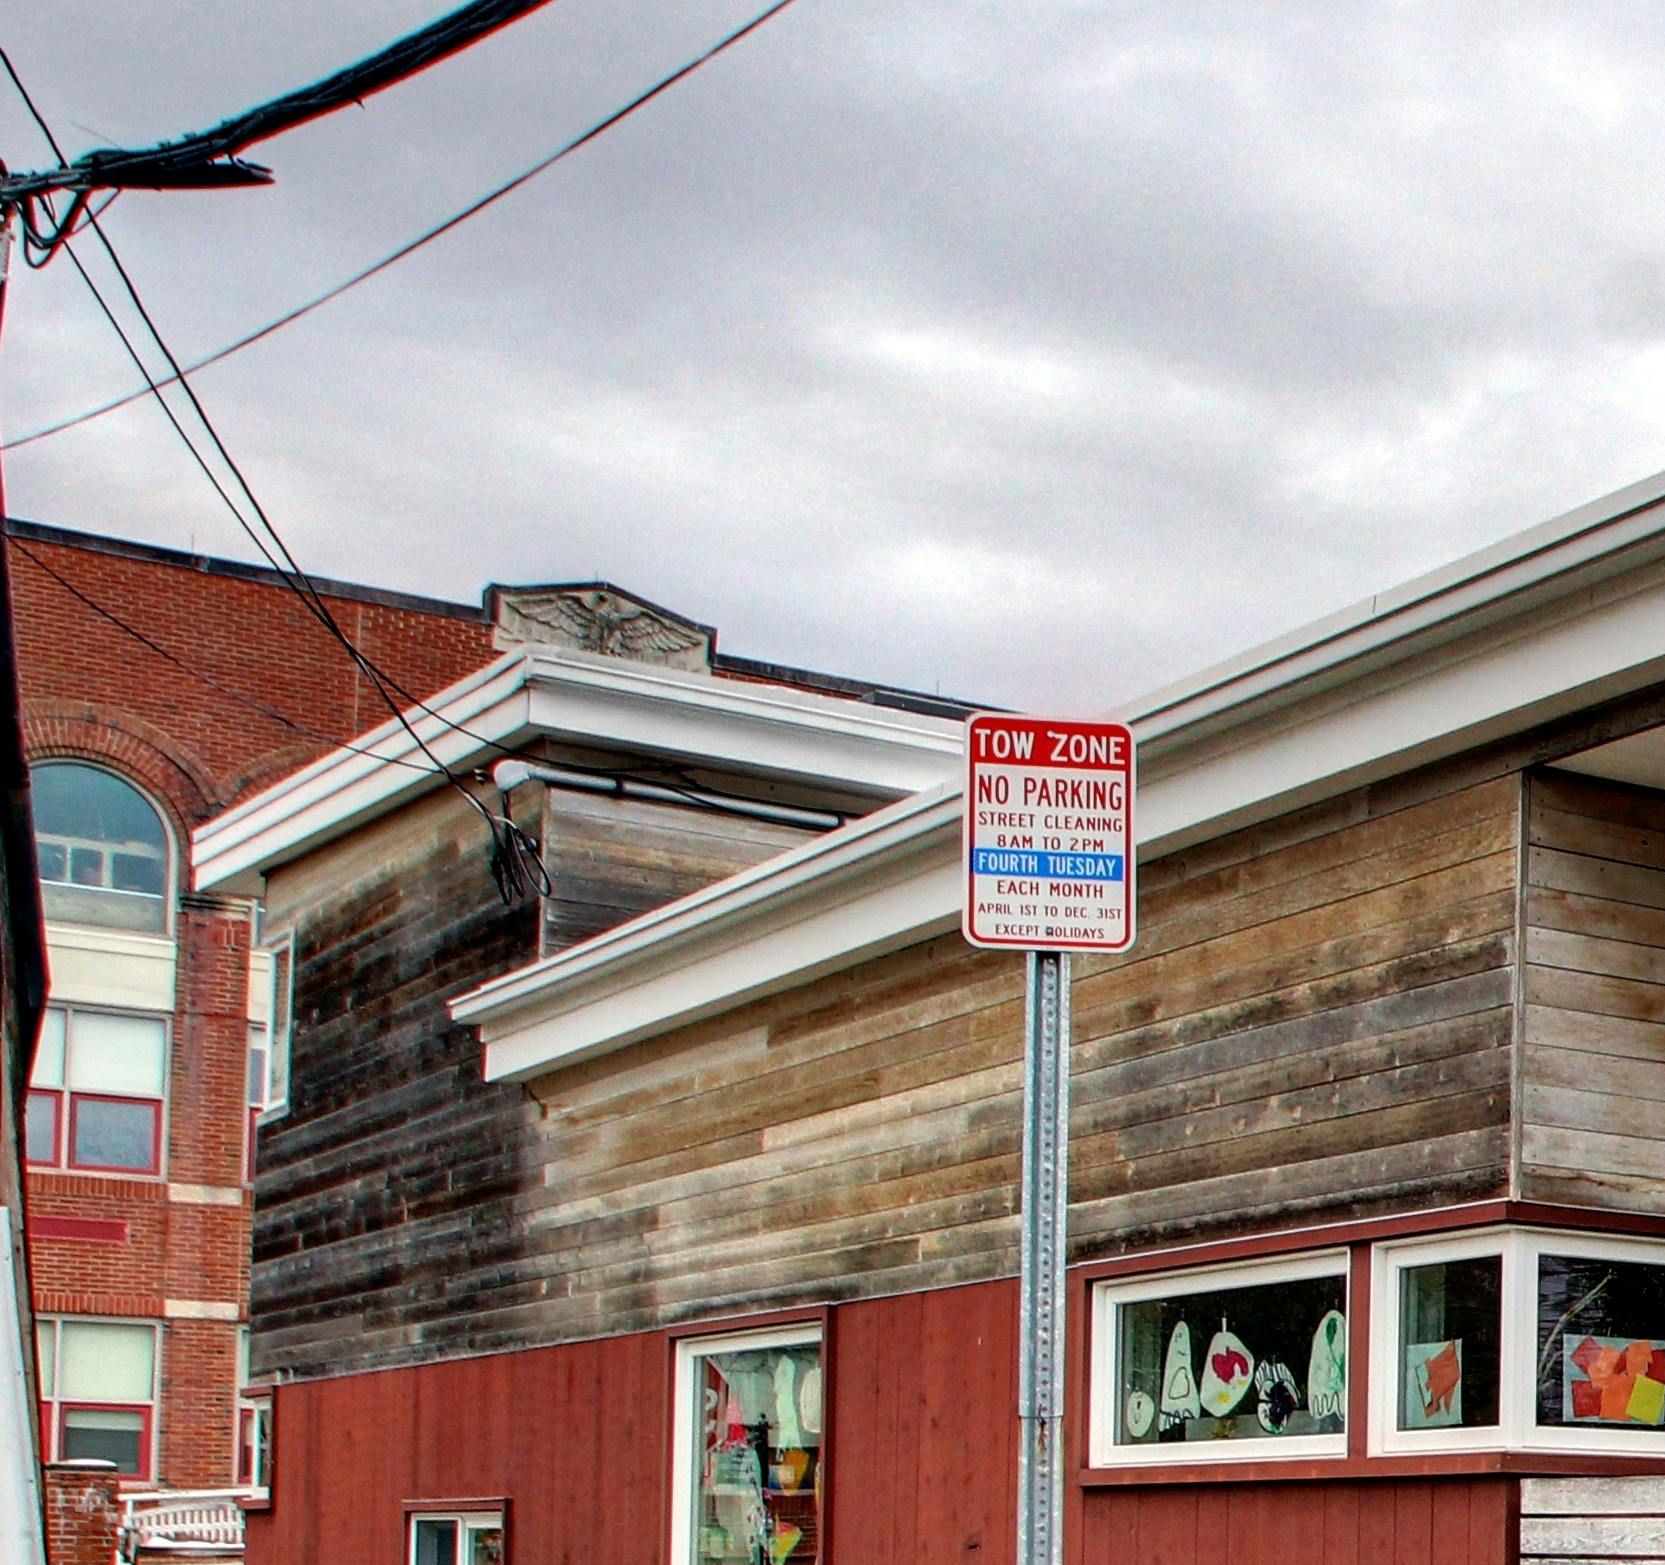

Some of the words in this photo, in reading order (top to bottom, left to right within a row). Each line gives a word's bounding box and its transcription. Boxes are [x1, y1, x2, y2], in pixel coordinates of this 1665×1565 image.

[975, 728, 1035, 760] TOW
[1048, 732, 1126, 765] ZONE
[978, 774, 1010, 806] NO
[1023, 776, 1123, 812] PARKING
[978, 810, 1036, 829] STREET
[1043, 814, 1123, 833] CLEANING
[1042, 836, 1061, 851] TO
[978, 851, 1039, 874] FOURTH
[1047, 855, 1117, 877] TUESDAY
[997, 879, 1040, 897] EACH
[1049, 882, 1104, 899] MONTH
[978, 902, 1013, 916] APRIL
[1020, 904, 1038, 917] 1ST
[1044, 905, 1059, 918] TO
[1096, 907, 1123, 920] 31ST
[995, 923, 1041, 937] EXCEPT
